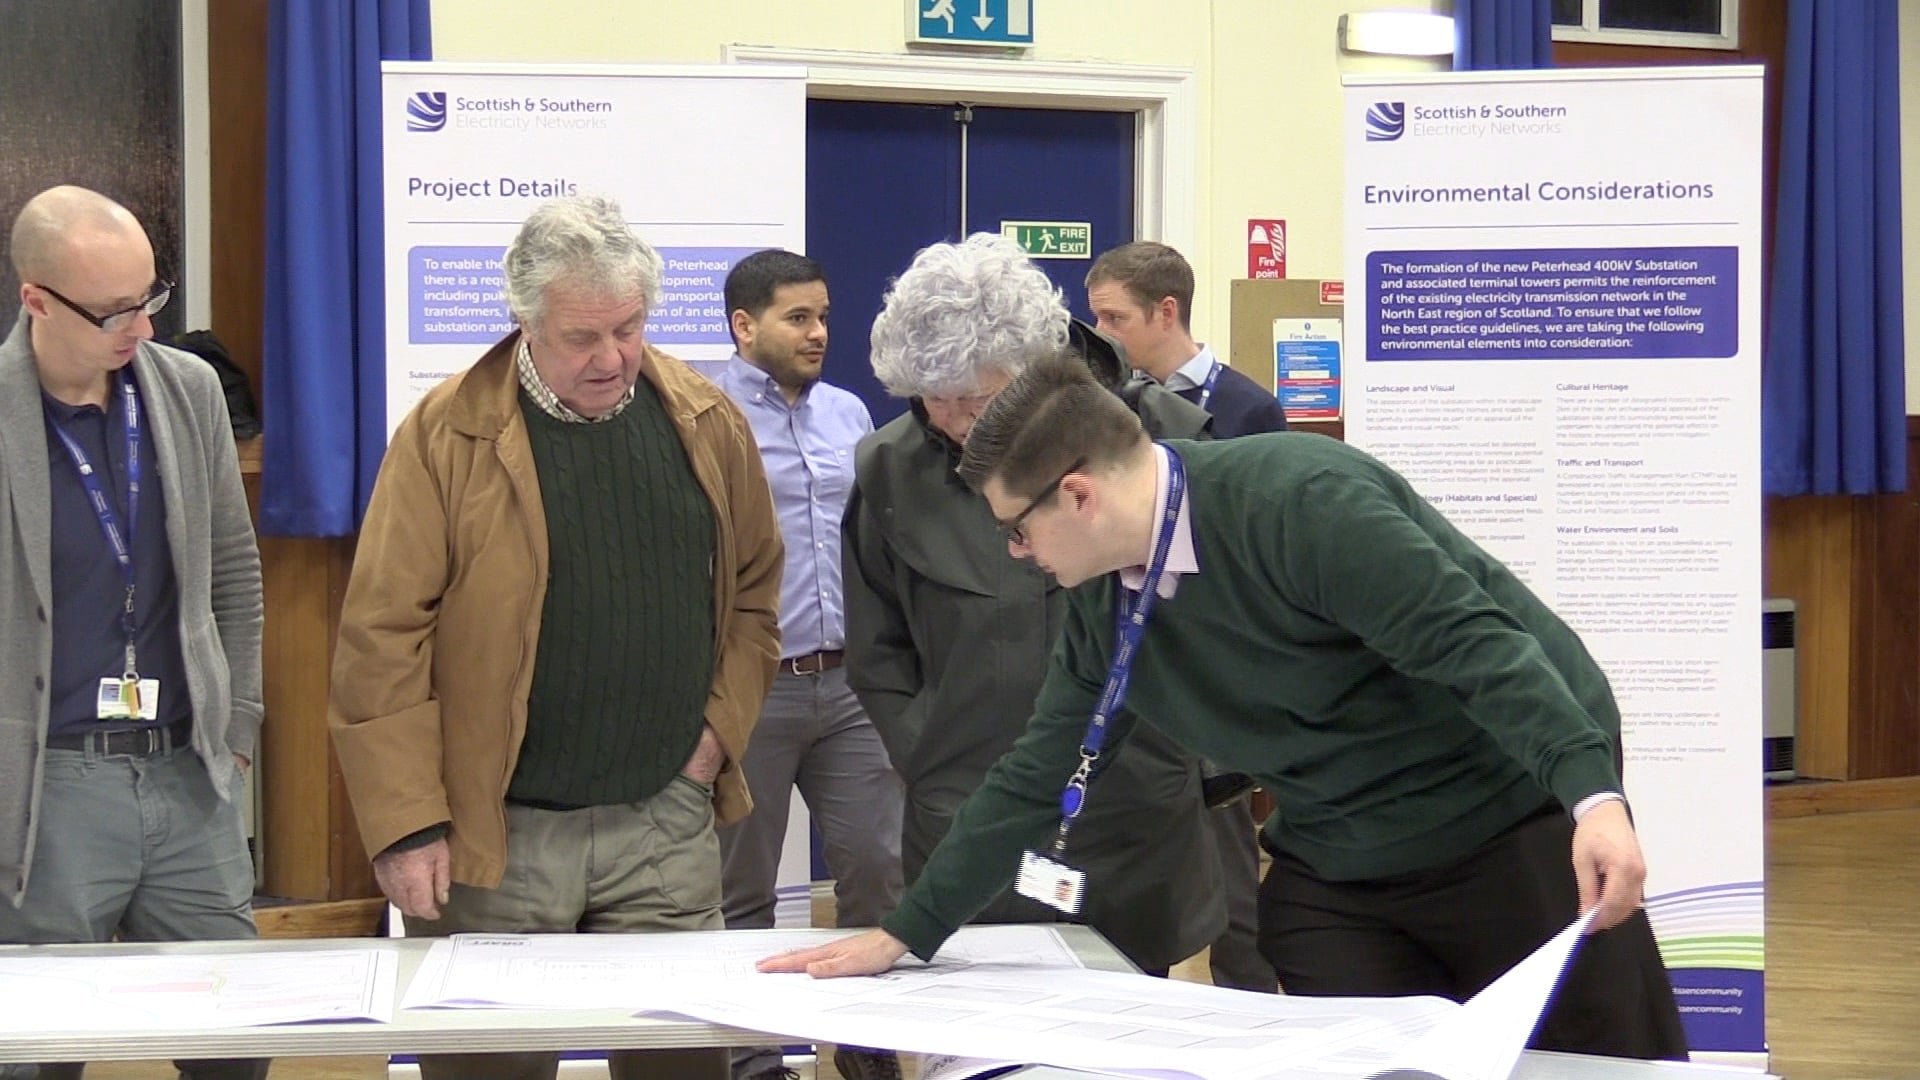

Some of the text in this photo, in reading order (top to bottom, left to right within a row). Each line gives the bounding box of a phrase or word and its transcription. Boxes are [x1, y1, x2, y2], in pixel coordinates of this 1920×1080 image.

[457, 98, 612, 112] Scottish & Southern
[1414, 105, 1566, 119] Scottish & Southern
[456, 115, 606, 131] Electricity Networks
[1414, 122, 1560, 139] Electricity Networks
[409, 178, 576, 202] Project Details
[1365, 181, 1713, 203] Environmental Considerations
[1060, 228, 1086, 238] FIRE
[1060, 243, 1085, 253] EXIT
[424, 259, 439, 270] To
[442, 259, 482, 270] enable
[669, 260, 728, 271] Peterhead
[1259, 257, 1275, 266] Fire
[1382, 260, 1697, 274] The formation of the new Peterhead 400kV Substation
[1256, 269, 1278, 279] point
[424, 275, 455, 285] there
[458, 275, 468, 285] is
[470, 277, 477, 285] a
[662, 276, 714, 288] lopment,
[1382, 275, 1716, 290] and associated terminal towers permits the reinforcement
[424, 290, 479, 304] including
[1382, 290, 1686, 306] of the existing electricity transmission network in the
[424, 306, 502, 317] transformers,
[671, 306, 683, 317] of
[686, 308, 700, 317] an
[1382, 305, 1701, 321] North East region of Scotland. To ensure that we follow
[424, 322, 486, 332] substation
[489, 322, 511, 332] and
[662, 322, 697, 332] works
[700, 322, 722, 332] and
[1382, 320, 1704, 337] the best practice guidelines, we are taking the following
[1382, 336, 1632, 350] environmental elements into consideration:
[1366, 384, 1410, 394] Landscape
[1593, 383, 1628, 392] Heritage
[1604, 459, 1643, 468] Transport
[1446, 494, 1483, 504] (Habitats
[1504, 494, 1537, 503] Species)
